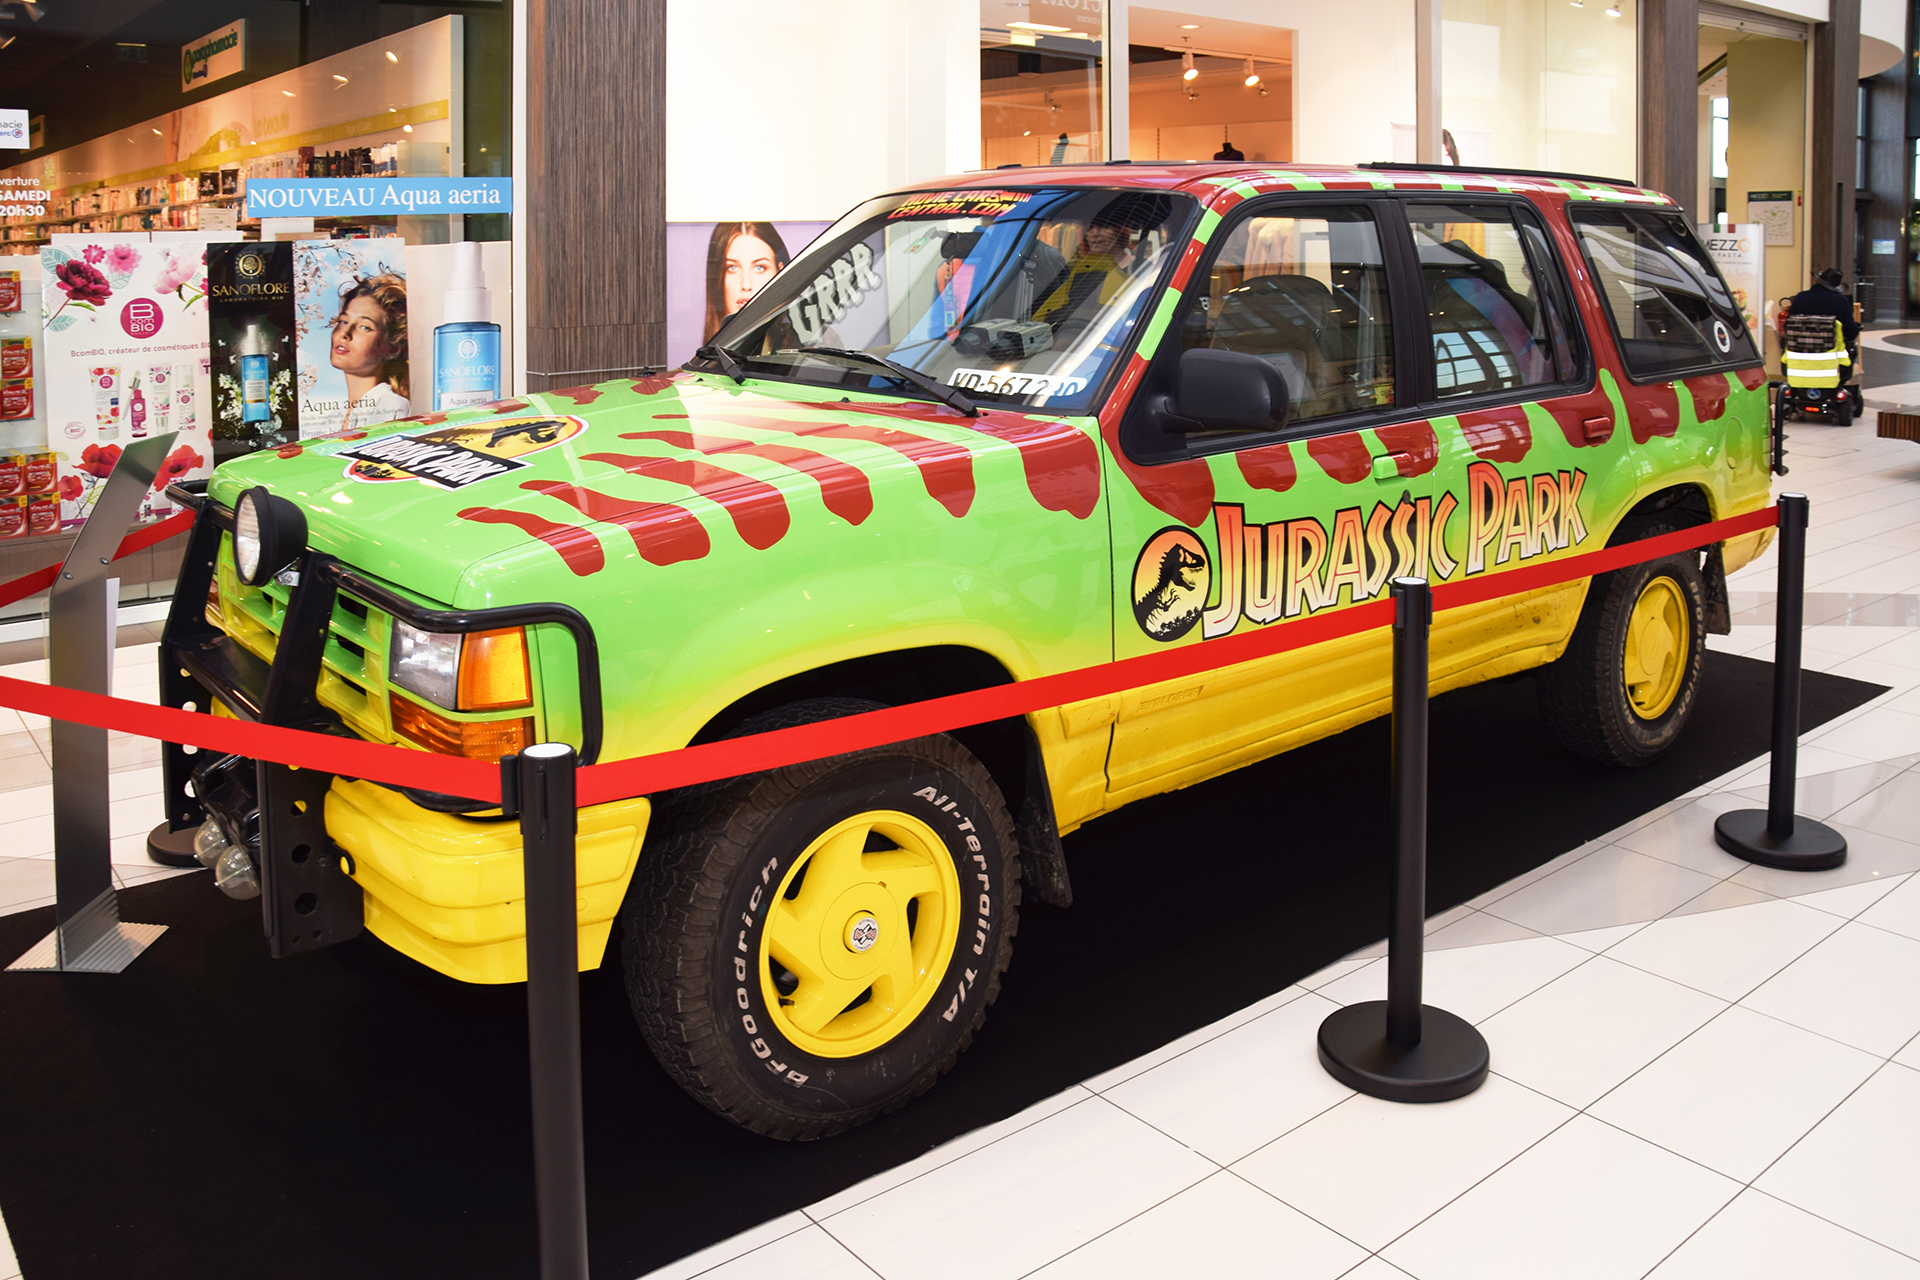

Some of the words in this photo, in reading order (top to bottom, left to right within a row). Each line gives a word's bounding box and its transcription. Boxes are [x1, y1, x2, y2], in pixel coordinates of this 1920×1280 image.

[249, 188, 375, 208] NOUVEAU
[380, 184, 442, 212] Aqua
[448, 183, 501, 205] aeria
[901, 191, 951, 208] MOVIE
[952, 190, 1004, 203] CARS
[212, 282, 290, 297] SANOFLORE
[787, 242, 883, 346] GRRR
[129, 303, 154, 319] B
[131, 323, 155, 332] BIO
[108, 346, 140, 355] créateur
[153, 342, 199, 353] cosmétiques
[439, 365, 496, 378] SANOFLORE
[301, 399, 340, 415] Aqua
[343, 395, 377, 409] aeria
[449, 397, 468, 406] Aqua
[302, 430, 327, 438] Brume
[406, 451, 508, 484] PARK
[1202, 490, 1459, 641] JURASSIC
[1466, 460, 1588, 575] PARK
[1140, 687, 1200, 711] EXPLORER
[912, 785, 992, 956] All-Terrain
[943, 966, 979, 1023] T/A
